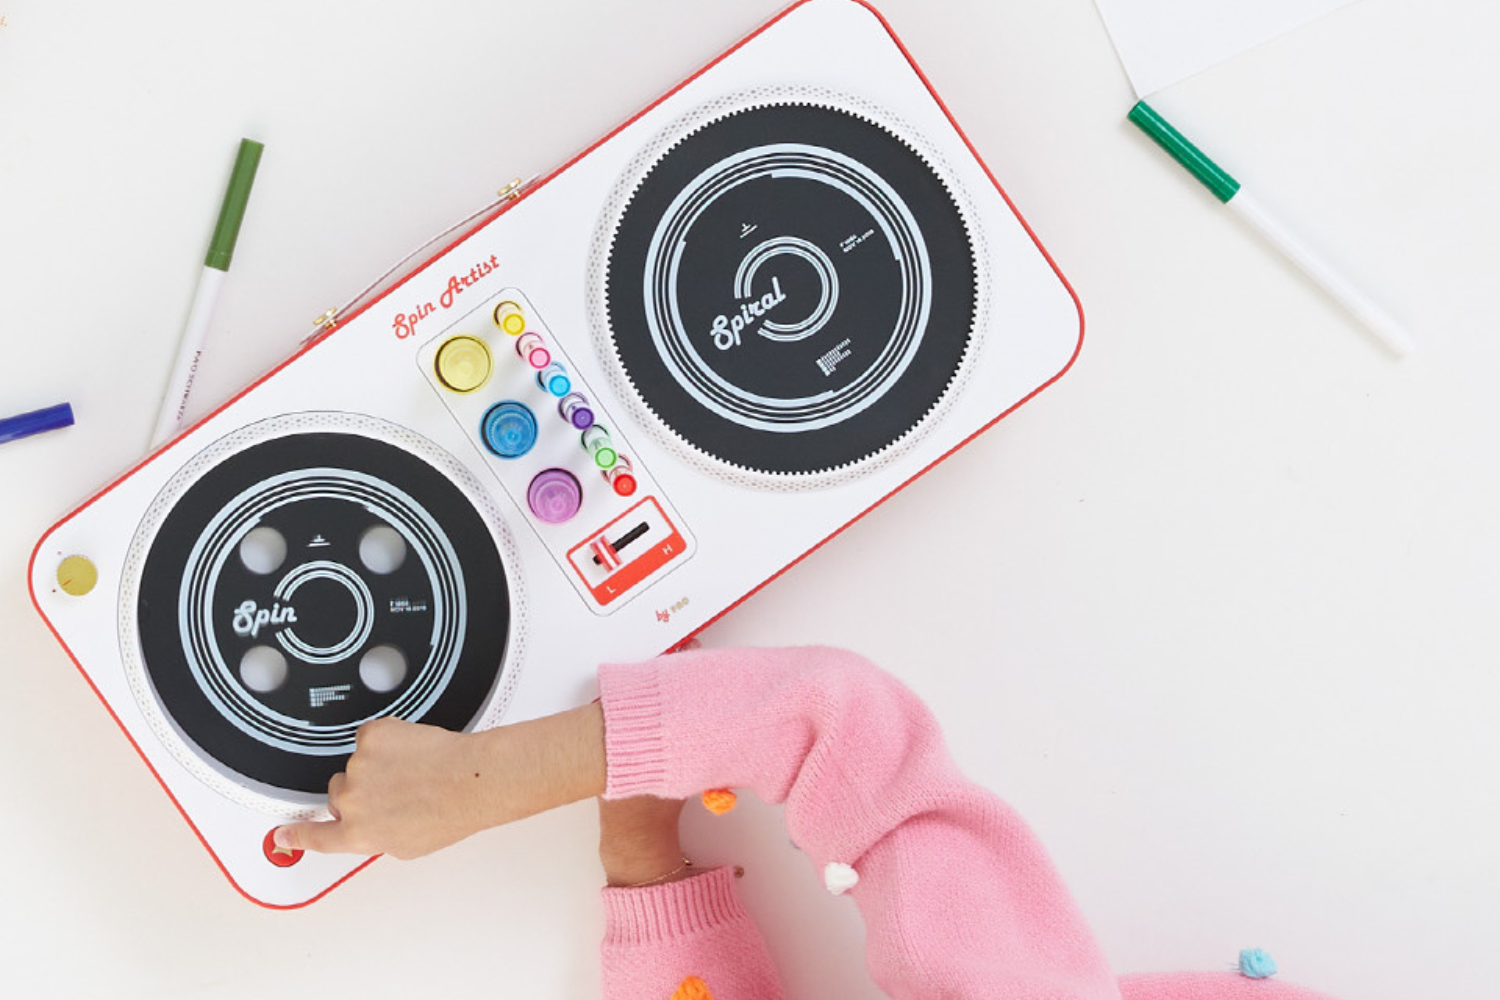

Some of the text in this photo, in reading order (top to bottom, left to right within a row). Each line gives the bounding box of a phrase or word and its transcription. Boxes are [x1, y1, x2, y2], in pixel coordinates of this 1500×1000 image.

[392, 254, 500, 339] Spin Artist
[710, 276, 787, 351] Spiral
[662, 544, 673, 555] H
[606, 585, 616, 595] L
[232, 600, 298, 637] Spin
[655, 609, 670, 623] by
